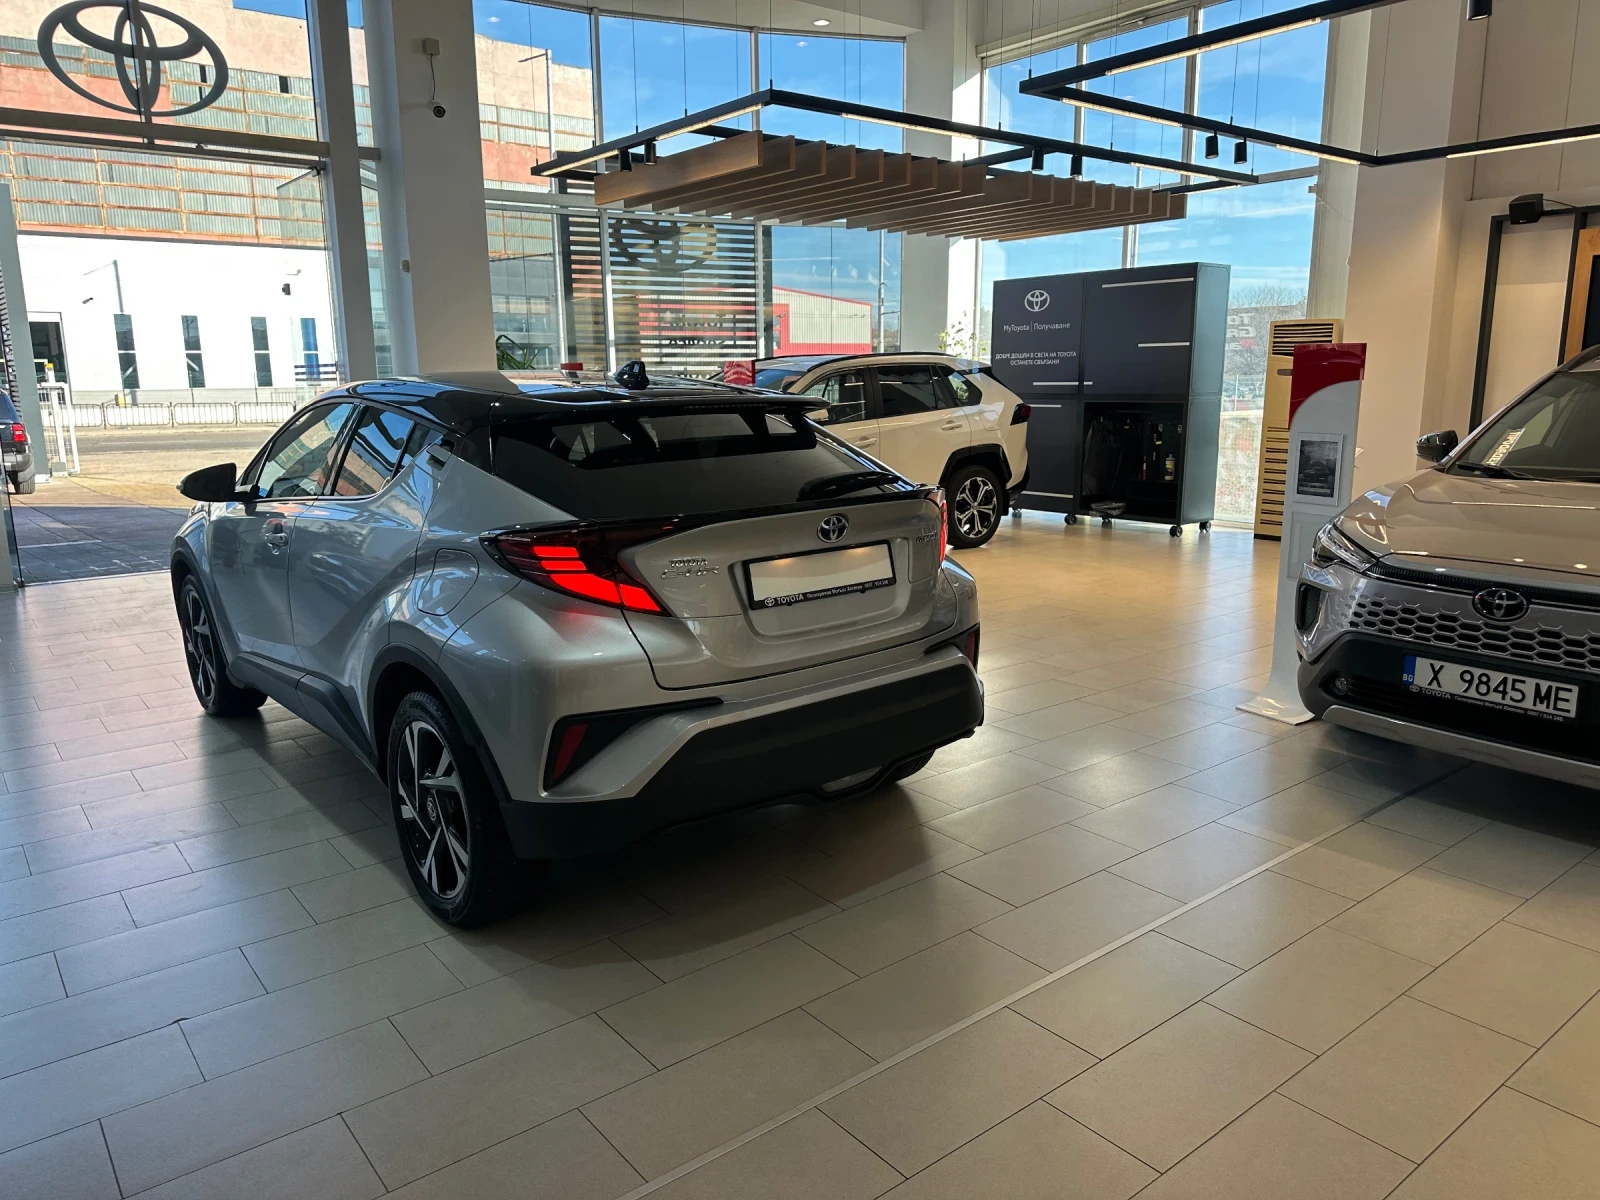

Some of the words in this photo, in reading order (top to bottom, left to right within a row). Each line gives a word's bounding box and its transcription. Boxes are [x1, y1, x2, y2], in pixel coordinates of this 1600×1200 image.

[1003, 324, 1030, 333] MyToyota
[1033, 322, 1071, 331] Получаване
[668, 558, 708, 568] TOYOTA
[661, 565, 719, 579] C-HR
[776, 593, 804, 604] TOYOTA
[1402, 673, 1414, 682] BG
[1421, 687, 1450, 699] TOYOTA
[1427, 662, 1445, 688] X
[1459, 669, 1526, 703] 9845
[1532, 682, 1573, 714] ME
